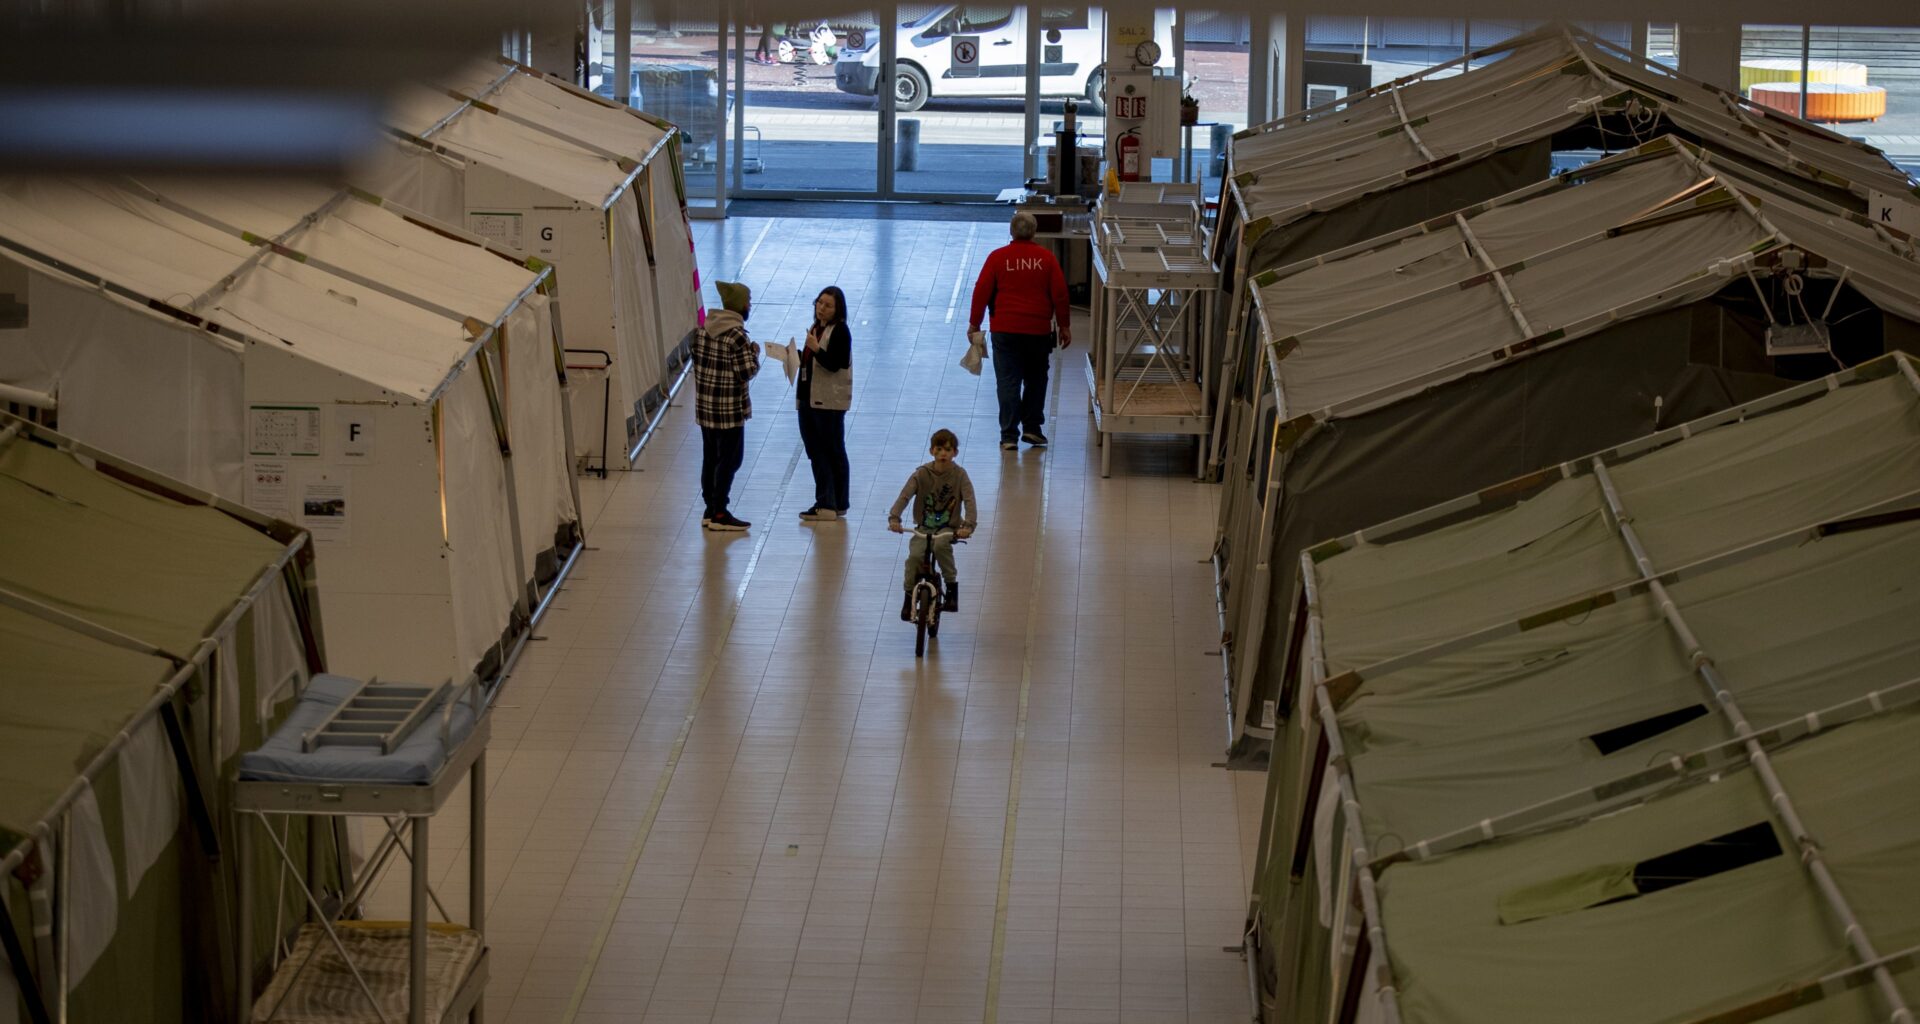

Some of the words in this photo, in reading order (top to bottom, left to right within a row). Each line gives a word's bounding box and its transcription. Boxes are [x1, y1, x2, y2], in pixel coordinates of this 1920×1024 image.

[1119, 27, 1136, 36] SAL
[1140, 27, 1146, 36] 2
[1881, 208, 1892, 222] K
[541, 227, 553, 241] G
[1006, 258, 1043, 271] LINK
[349, 423, 361, 442] F
